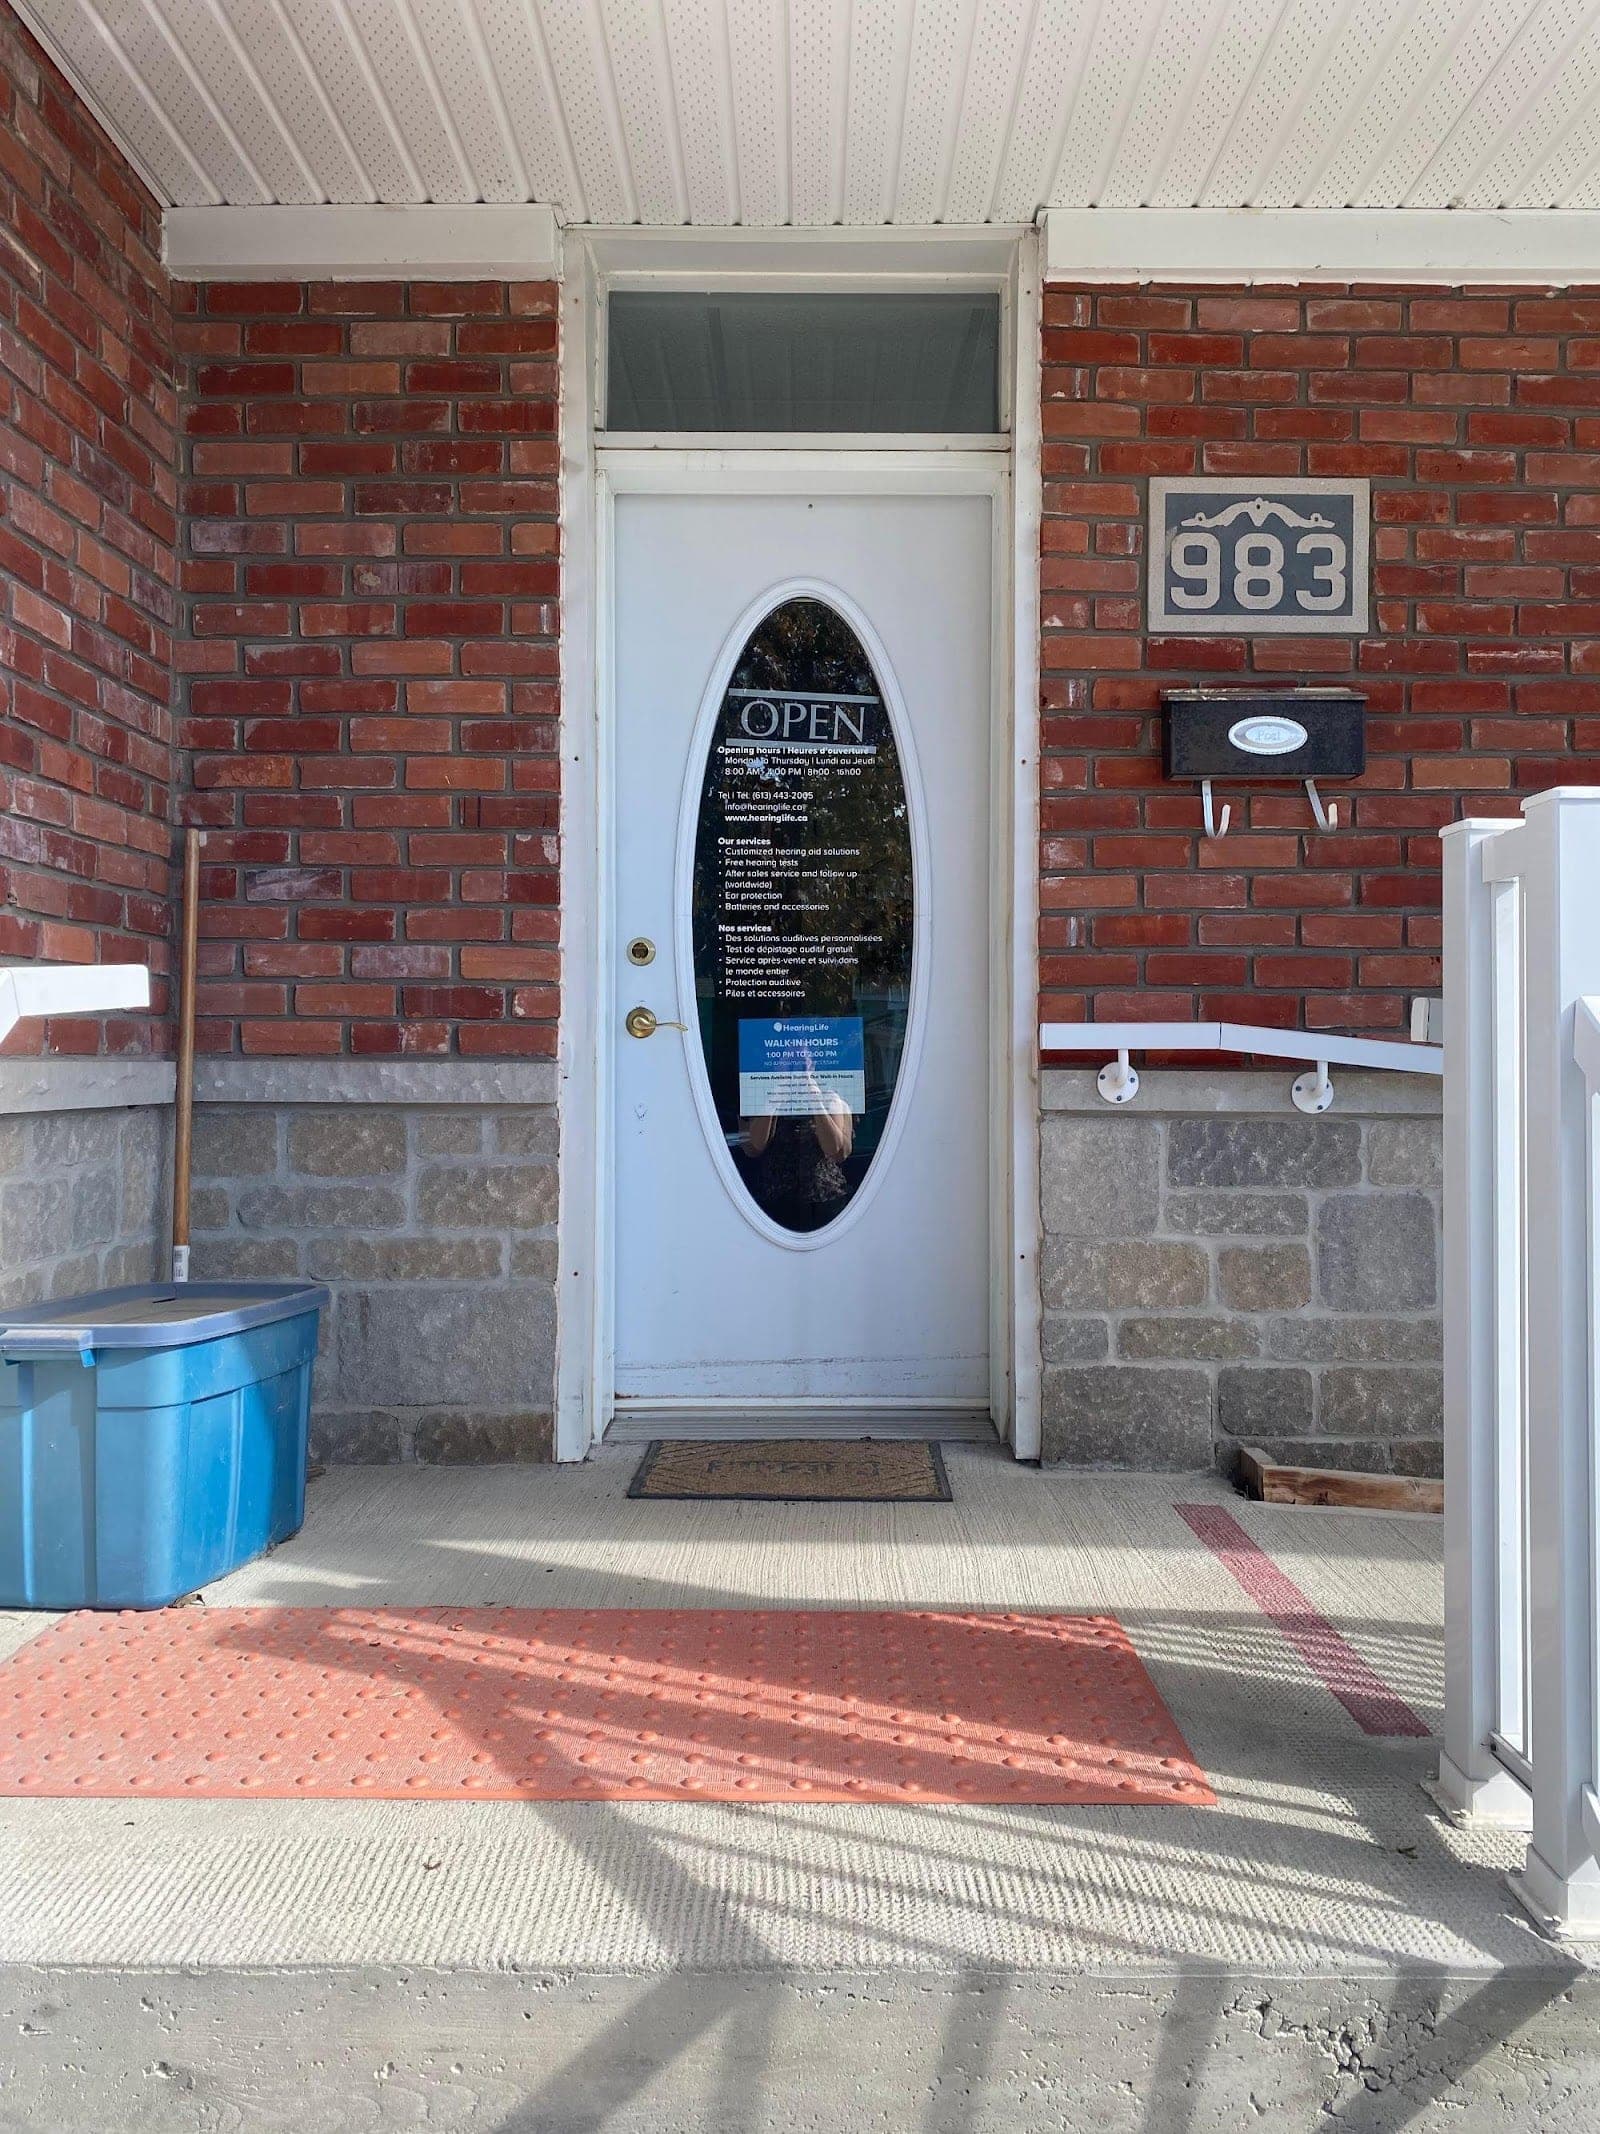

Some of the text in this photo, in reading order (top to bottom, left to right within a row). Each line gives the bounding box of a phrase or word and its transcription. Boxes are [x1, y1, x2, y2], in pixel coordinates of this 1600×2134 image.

[1170, 532, 1346, 611] 983
[741, 700, 865, 743] OPEN
[718, 746, 754, 756] Opening
[756, 746, 781, 754] hours
[787, 747, 818, 755] Heures
[819, 747, 869, 755] d'ouverture
[771, 757, 810, 766] Thursday
[815, 757, 839, 765] Lundi
[852, 757, 876, 765] Jeudi
[724, 767, 744, 776] 8:00
[746, 767, 760, 776] AM
[788, 768, 802, 776] PM
[807, 768, 830, 776] 8h00
[752, 791, 771, 800] (613)
[773, 791, 814, 800] 443-2005
[724, 802, 804, 813] info@hearinglife.ca
[724, 813, 808, 824] www.hearinglife.ca
[717, 837, 771, 845] Our services
[725, 848, 860, 858] Customized hearing aid solutions
[725, 859, 799, 868] Free hearing tests
[725, 870, 858, 880] After sales service and follow up
[724, 880, 773, 890] (worldwide)
[725, 892, 783, 901] Ear protection
[725, 903, 830, 911] Batteries and accessories
[718, 924, 772, 932] Nos services
[725, 934, 883, 944] Des solutions auditives personnalisées
[725, 945, 853, 955] Test de dépistage auditif gratuit
[725, 956, 756, 964] Service
[757, 956, 807, 966] après-vente
[818, 956, 837, 965] suivi
[838, 956, 859, 965] dans
[725, 967, 790, 975] le monde entier
[725, 978, 802, 986] Protection auditive
[725, 989, 806, 998] Piles et accessoires
[783, 1023, 829, 1033] HearingLife
[764, 1038, 839, 1048] WALK-IN HOURS
